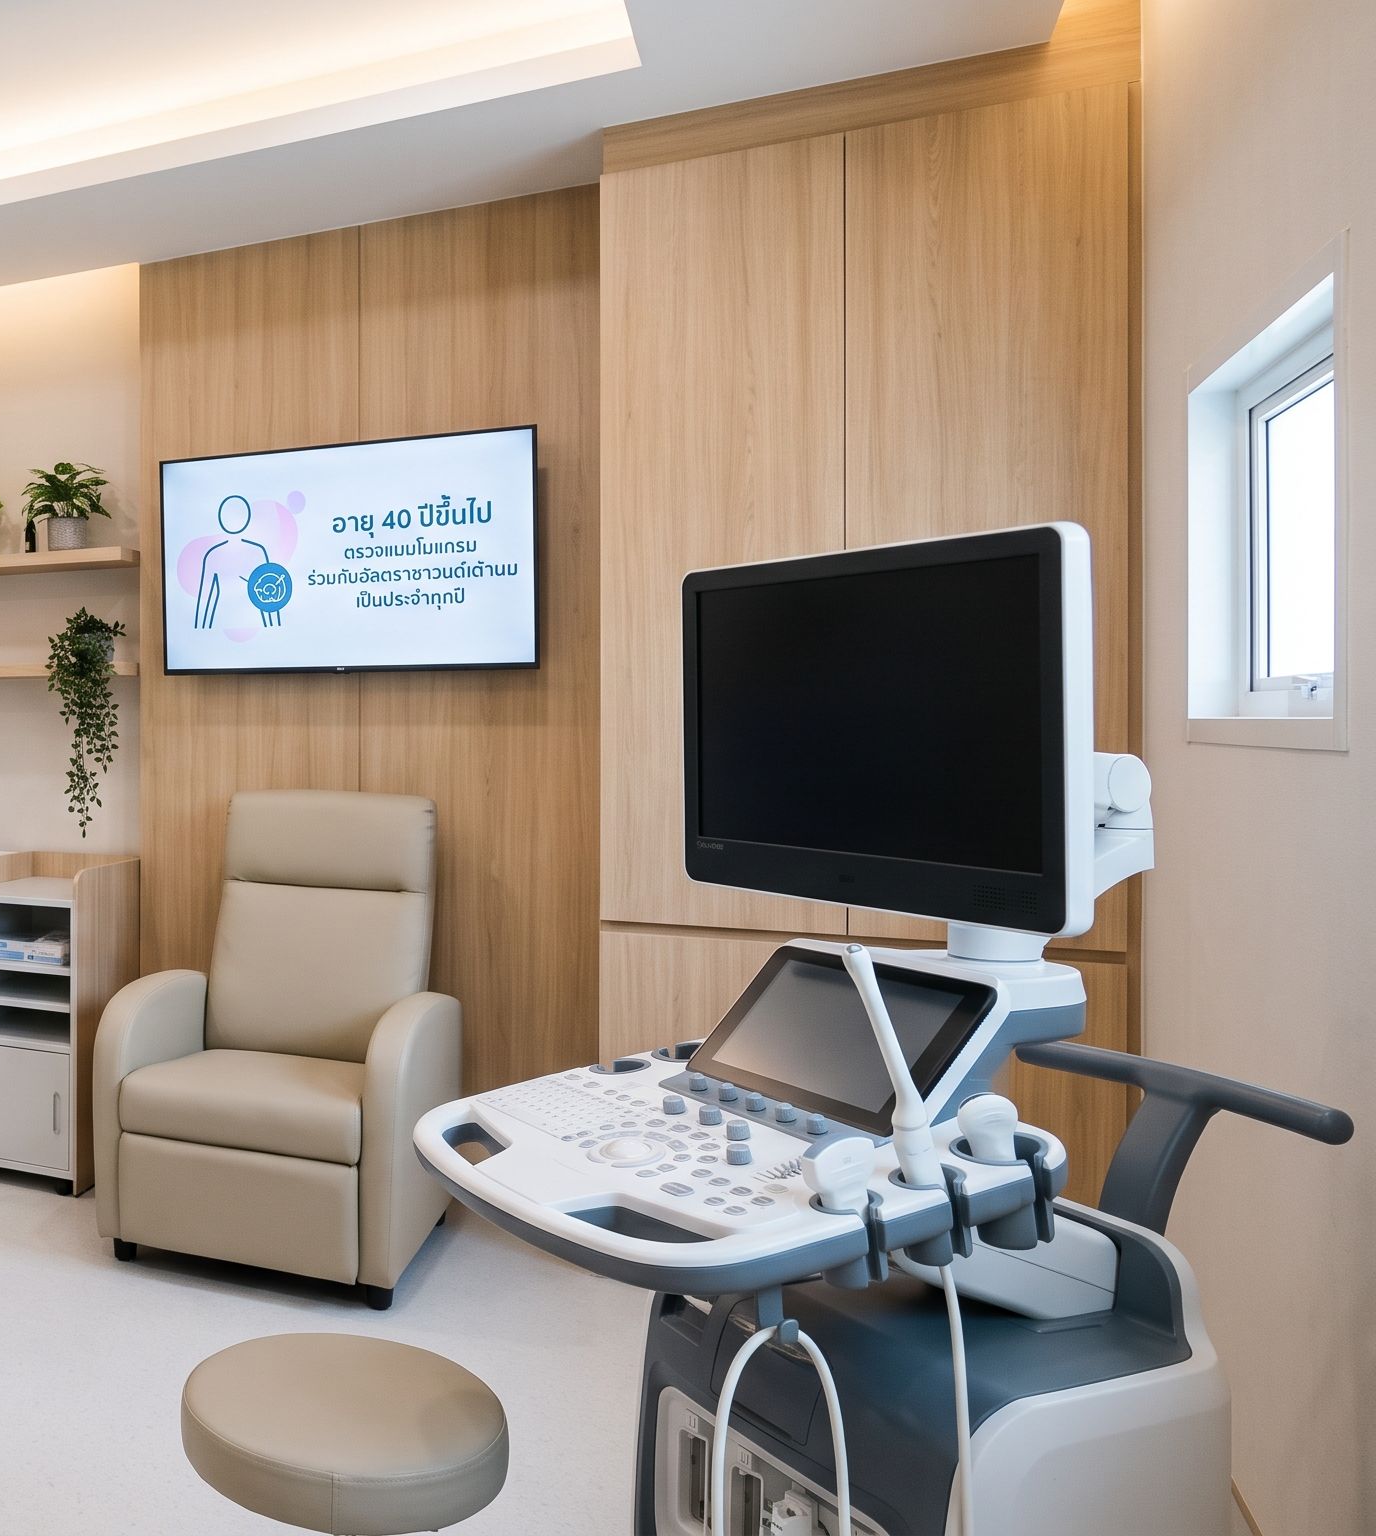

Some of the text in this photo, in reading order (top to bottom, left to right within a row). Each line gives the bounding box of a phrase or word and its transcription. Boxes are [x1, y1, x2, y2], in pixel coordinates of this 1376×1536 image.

[332, 494, 492, 539] อายุ 40 ปีขึ้นไป
[344, 536, 477, 560] ตรวจแมมโมแกรม
